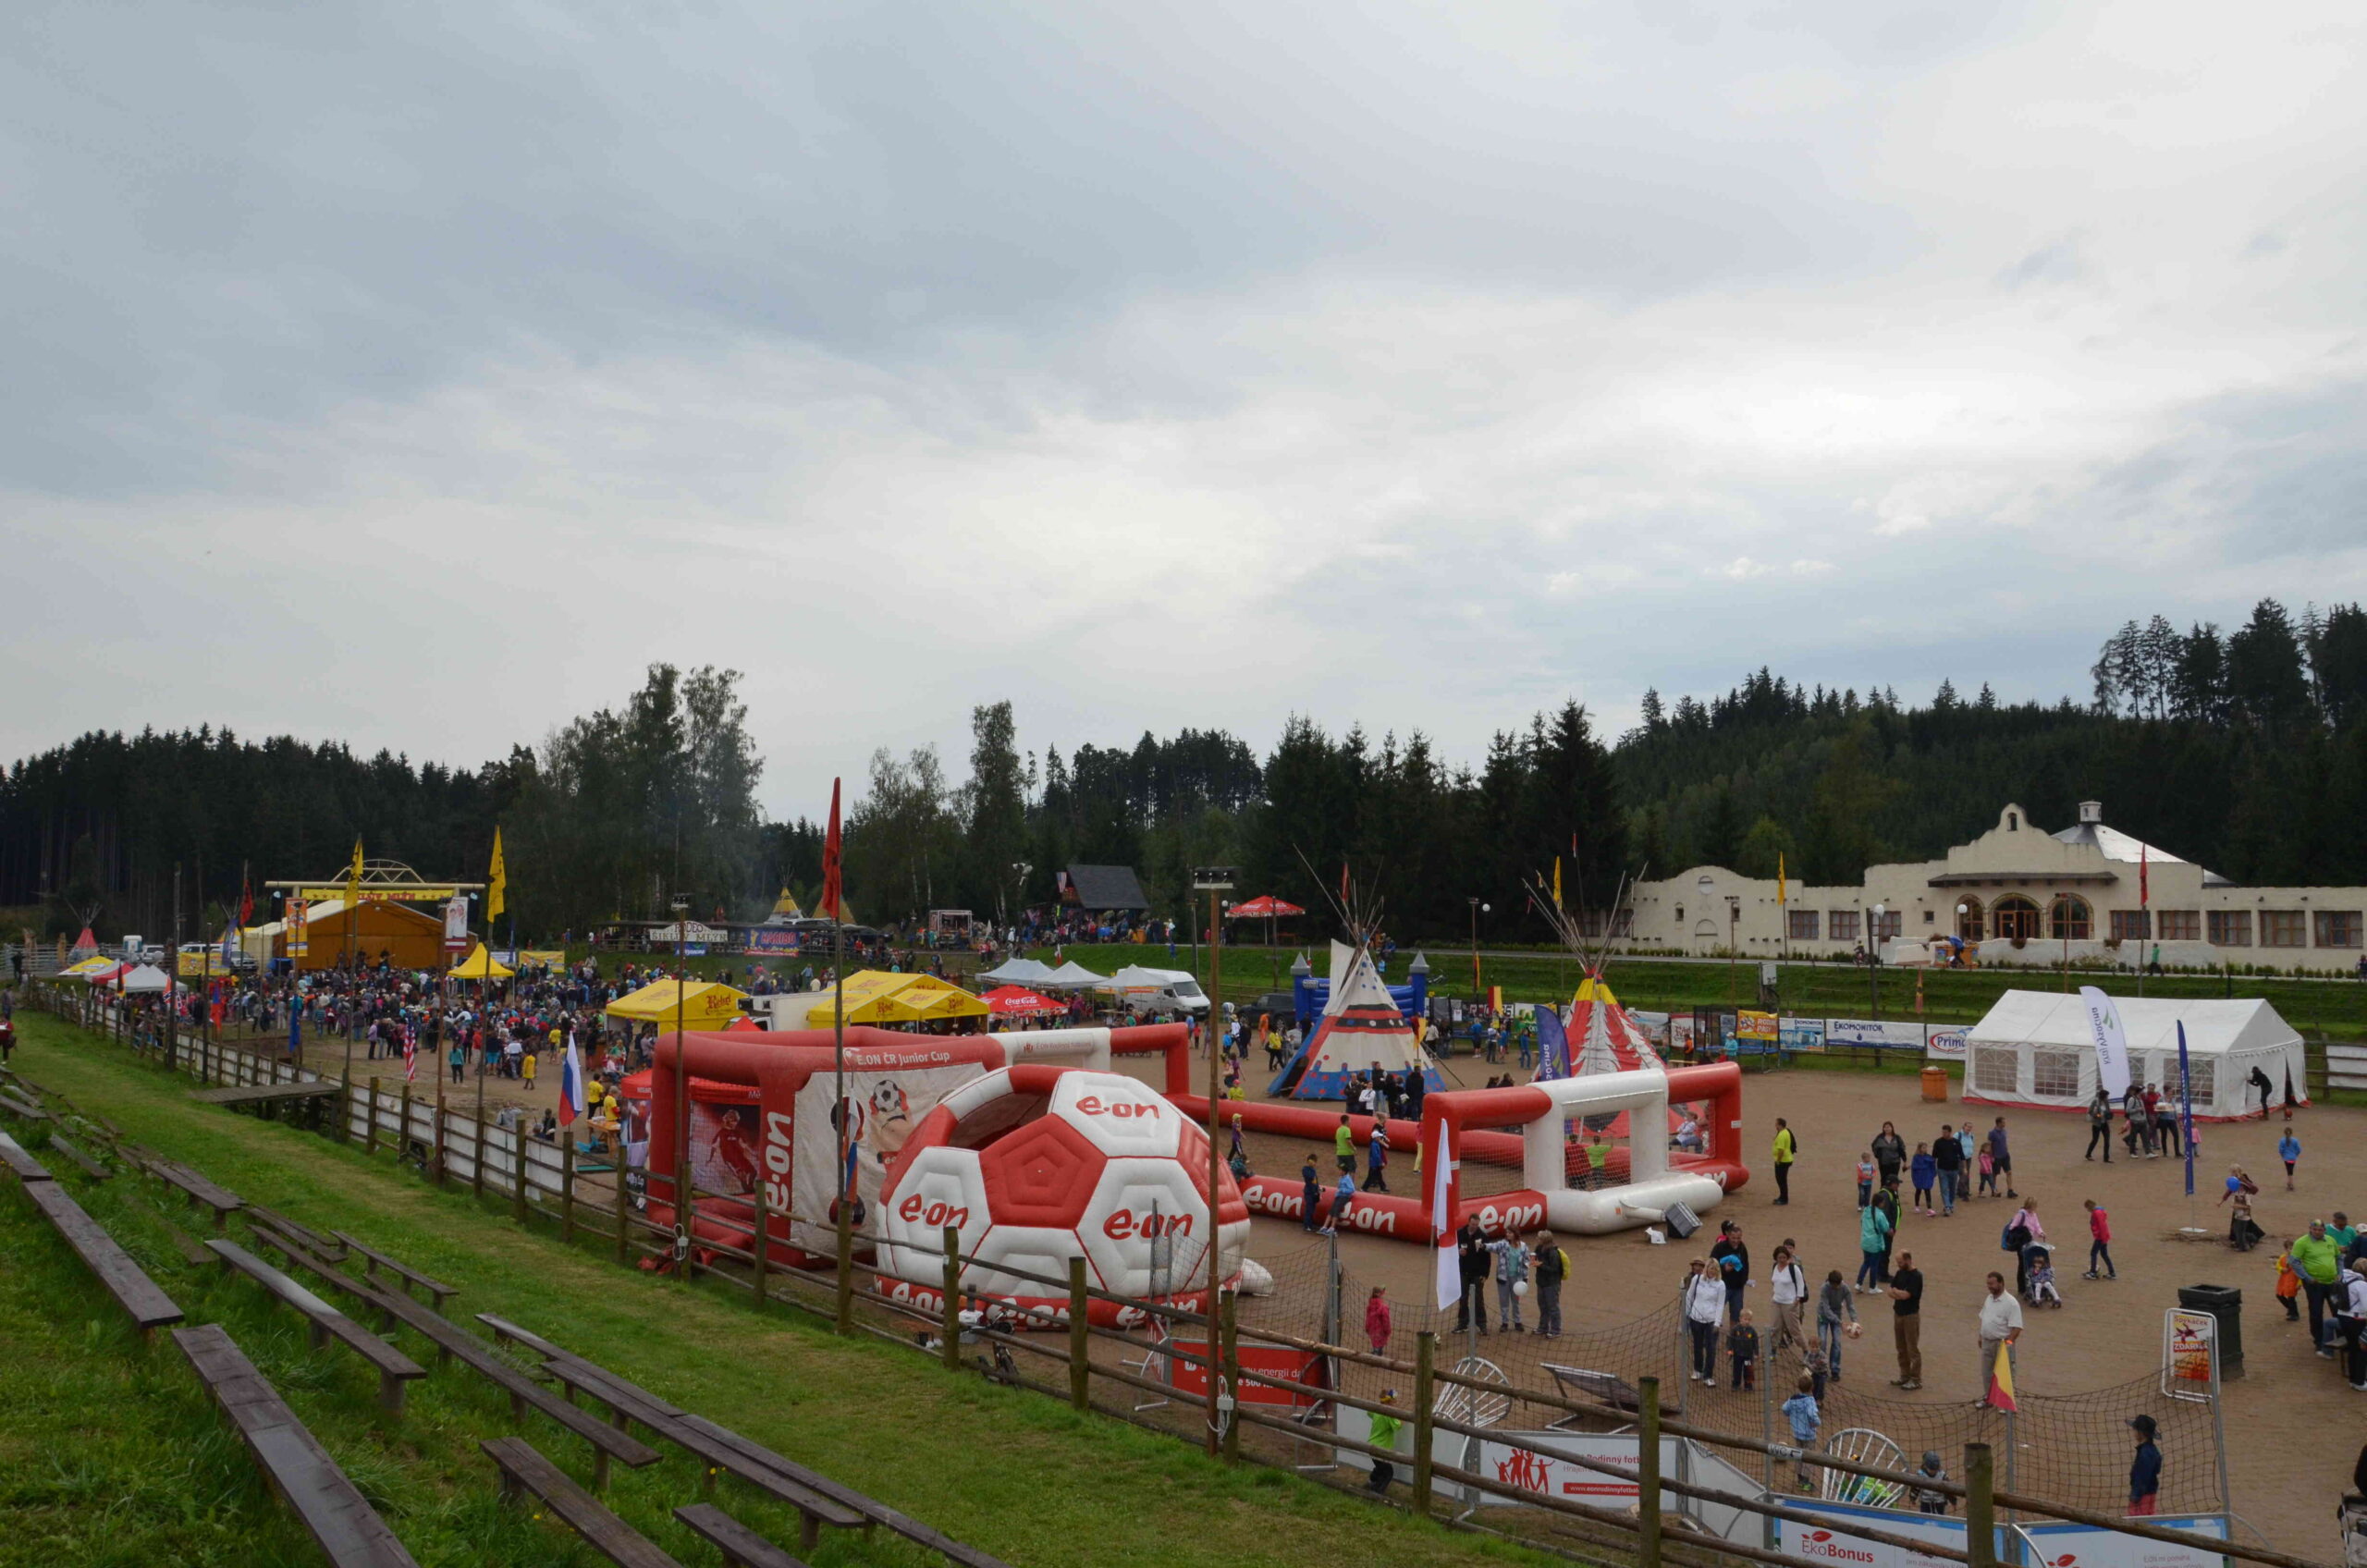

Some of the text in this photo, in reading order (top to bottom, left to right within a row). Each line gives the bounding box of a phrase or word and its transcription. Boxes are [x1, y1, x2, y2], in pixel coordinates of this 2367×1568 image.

[674, 921, 704, 933] RDEO
[1834, 1021, 1884, 1034] EKOMONITOR
[857, 1050, 950, 1065] E.ON ČR Junior Cup
[1801, 1539, 1875, 1563] EkoBonus
